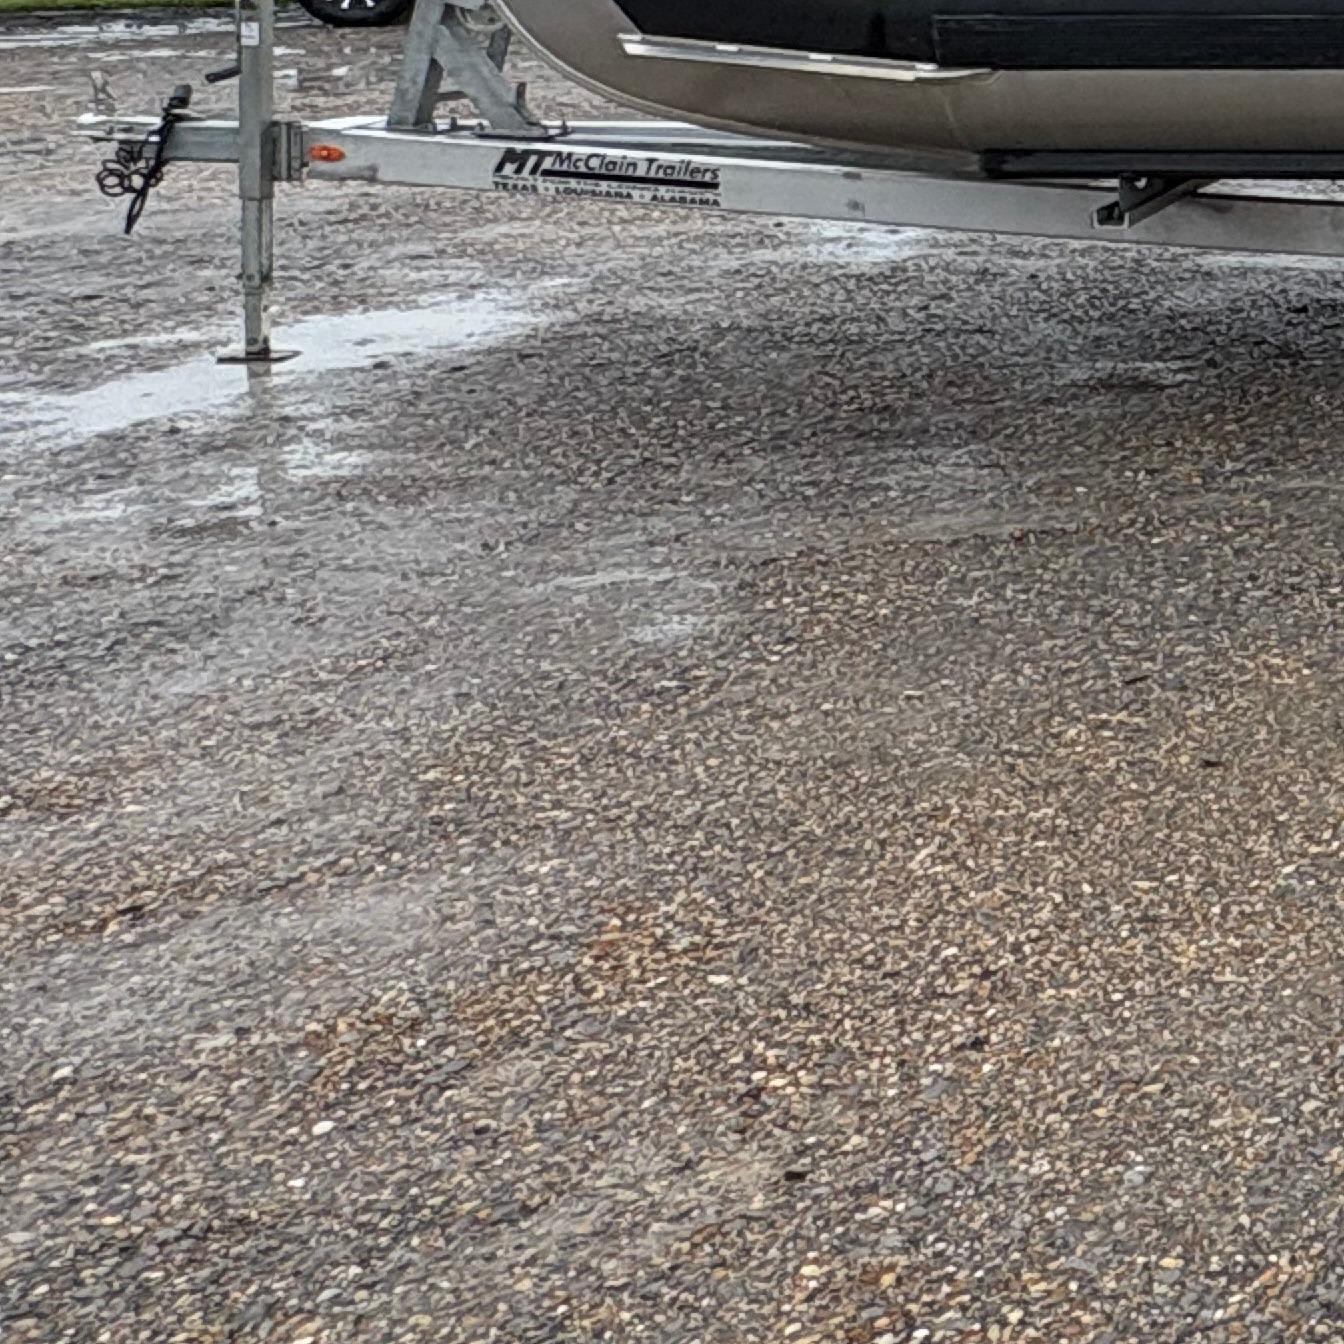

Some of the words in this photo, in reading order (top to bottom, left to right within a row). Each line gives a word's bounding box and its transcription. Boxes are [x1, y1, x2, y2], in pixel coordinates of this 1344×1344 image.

[492, 147, 562, 176] MT
[550, 152, 638, 175] McClain
[643, 158, 720, 180] Trailers
[554, 186, 635, 200] LOUISIANA
[651, 193, 722, 208] ALABAMA
